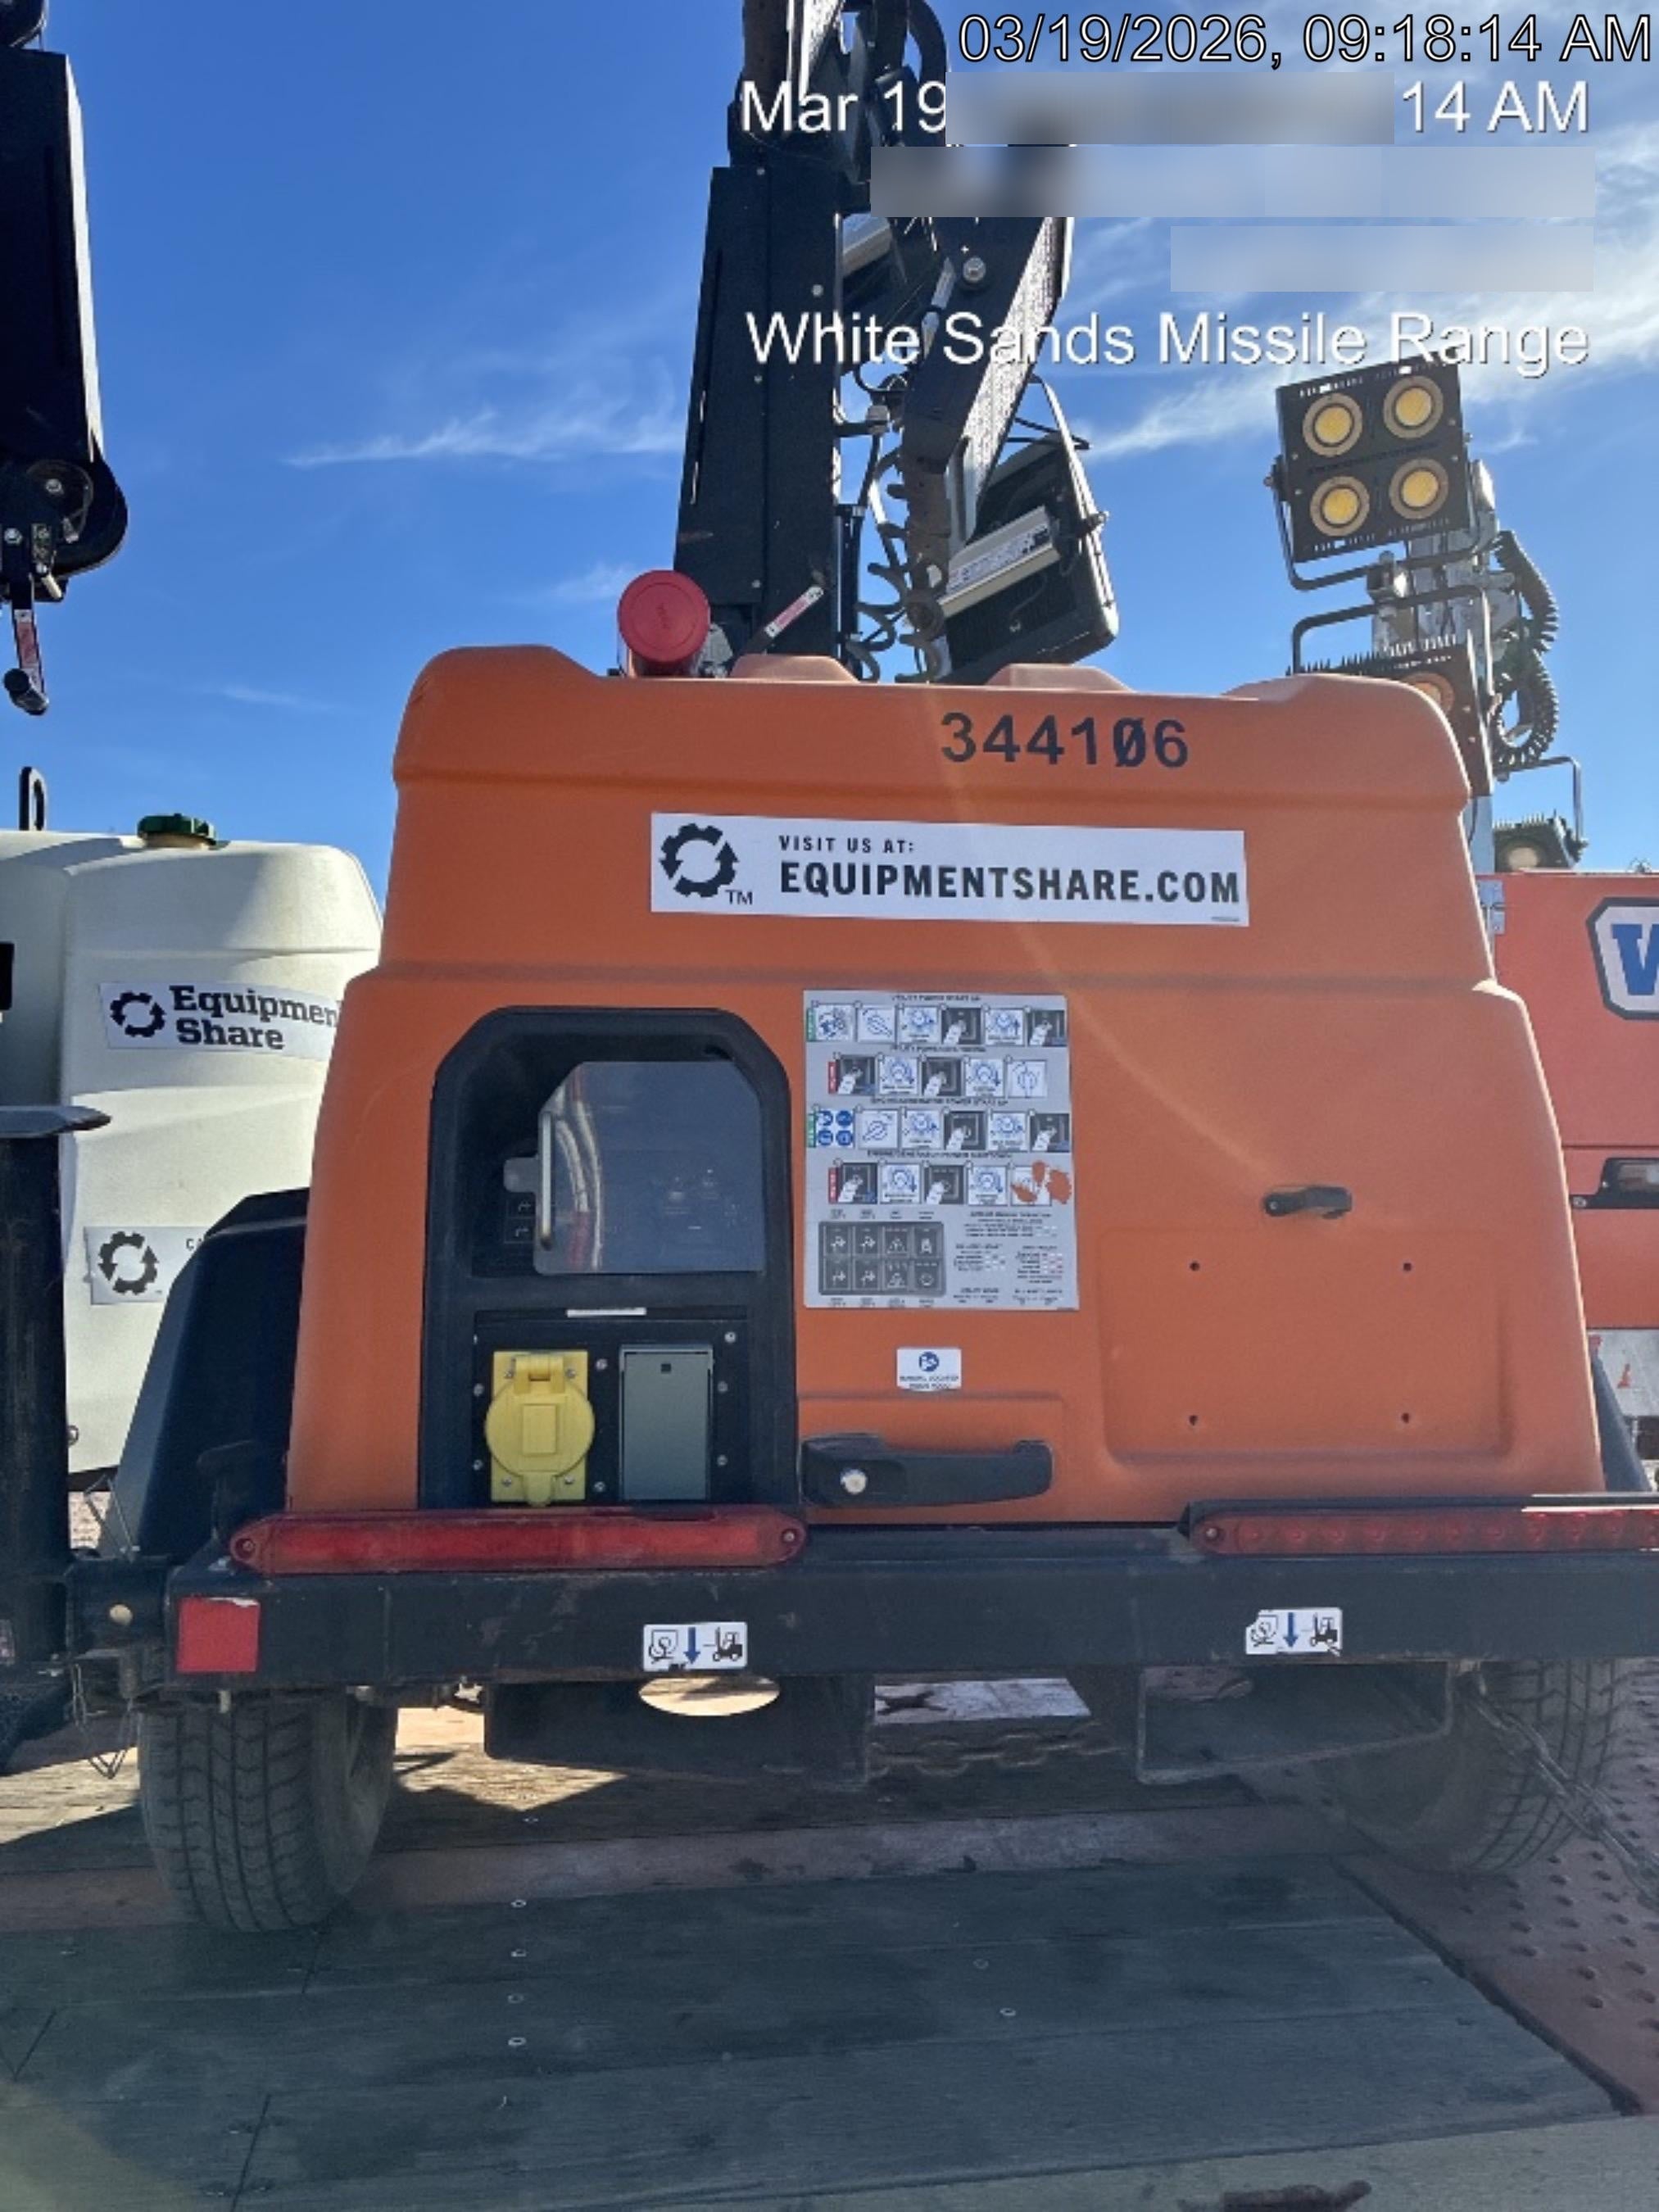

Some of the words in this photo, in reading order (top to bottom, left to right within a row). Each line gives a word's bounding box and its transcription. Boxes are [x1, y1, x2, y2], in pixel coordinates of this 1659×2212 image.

[941, 712, 1189, 768] 344106
[779, 835, 836, 852] VISIT
[847, 837, 872, 854] US
[884, 839, 914, 854] AT:
[725, 890, 753, 905] TM
[780, 861, 1240, 904] EQUIPMENTSHARE.COM
[169, 985, 341, 1028] Equipmen
[176, 1017, 286, 1049] Share
